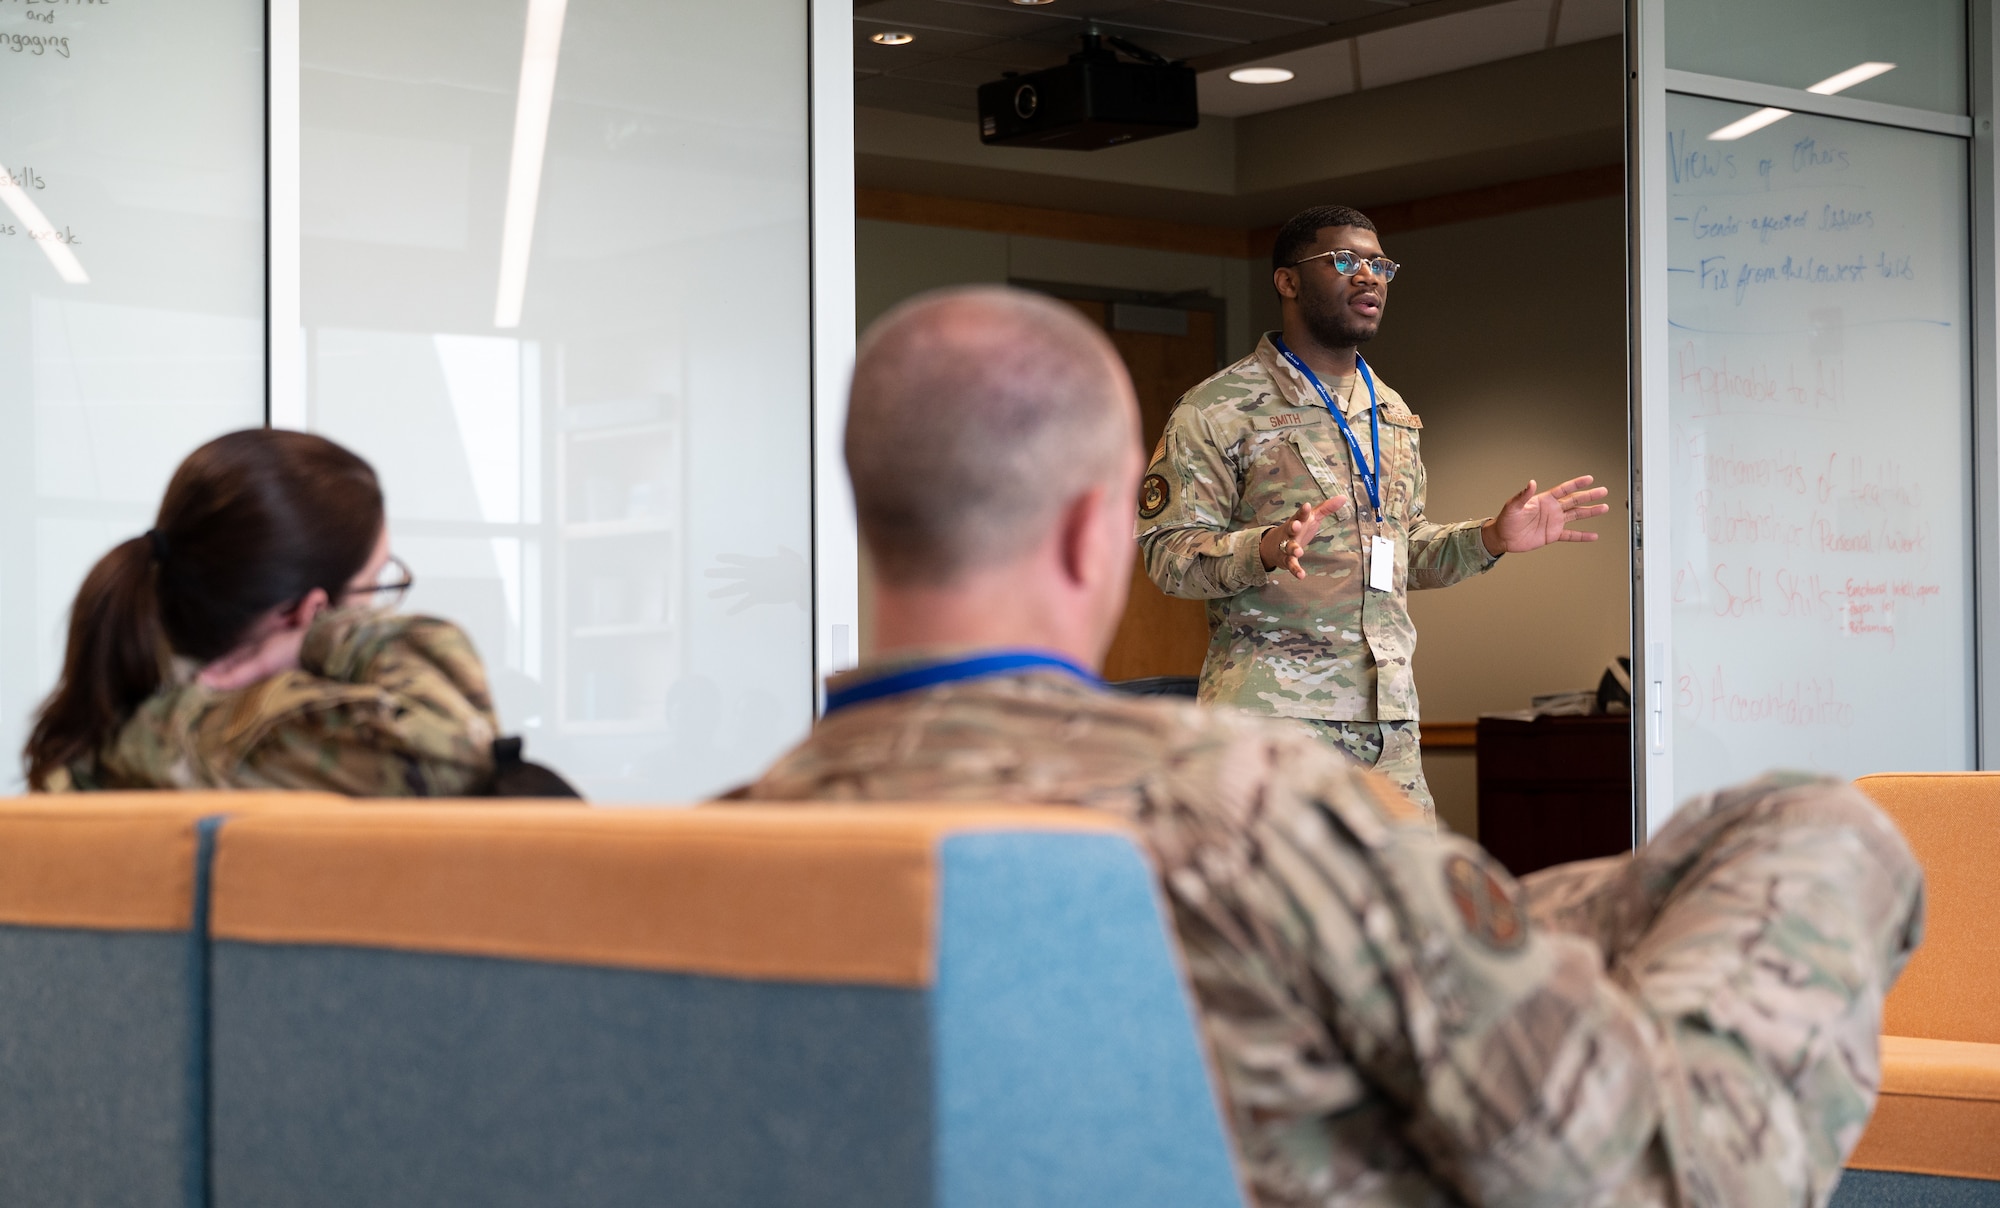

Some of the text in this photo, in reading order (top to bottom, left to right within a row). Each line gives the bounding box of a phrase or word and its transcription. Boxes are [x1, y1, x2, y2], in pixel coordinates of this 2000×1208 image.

[26, 9, 55, 24] and
[1669, 129, 1737, 184] Views
[1700, 255, 1729, 291] Fix
[1736, 263, 1779, 307] from
[1269, 412, 1302, 429] SMITH
[1817, 452, 1837, 505] of
[1713, 563, 1764, 619] Soft
